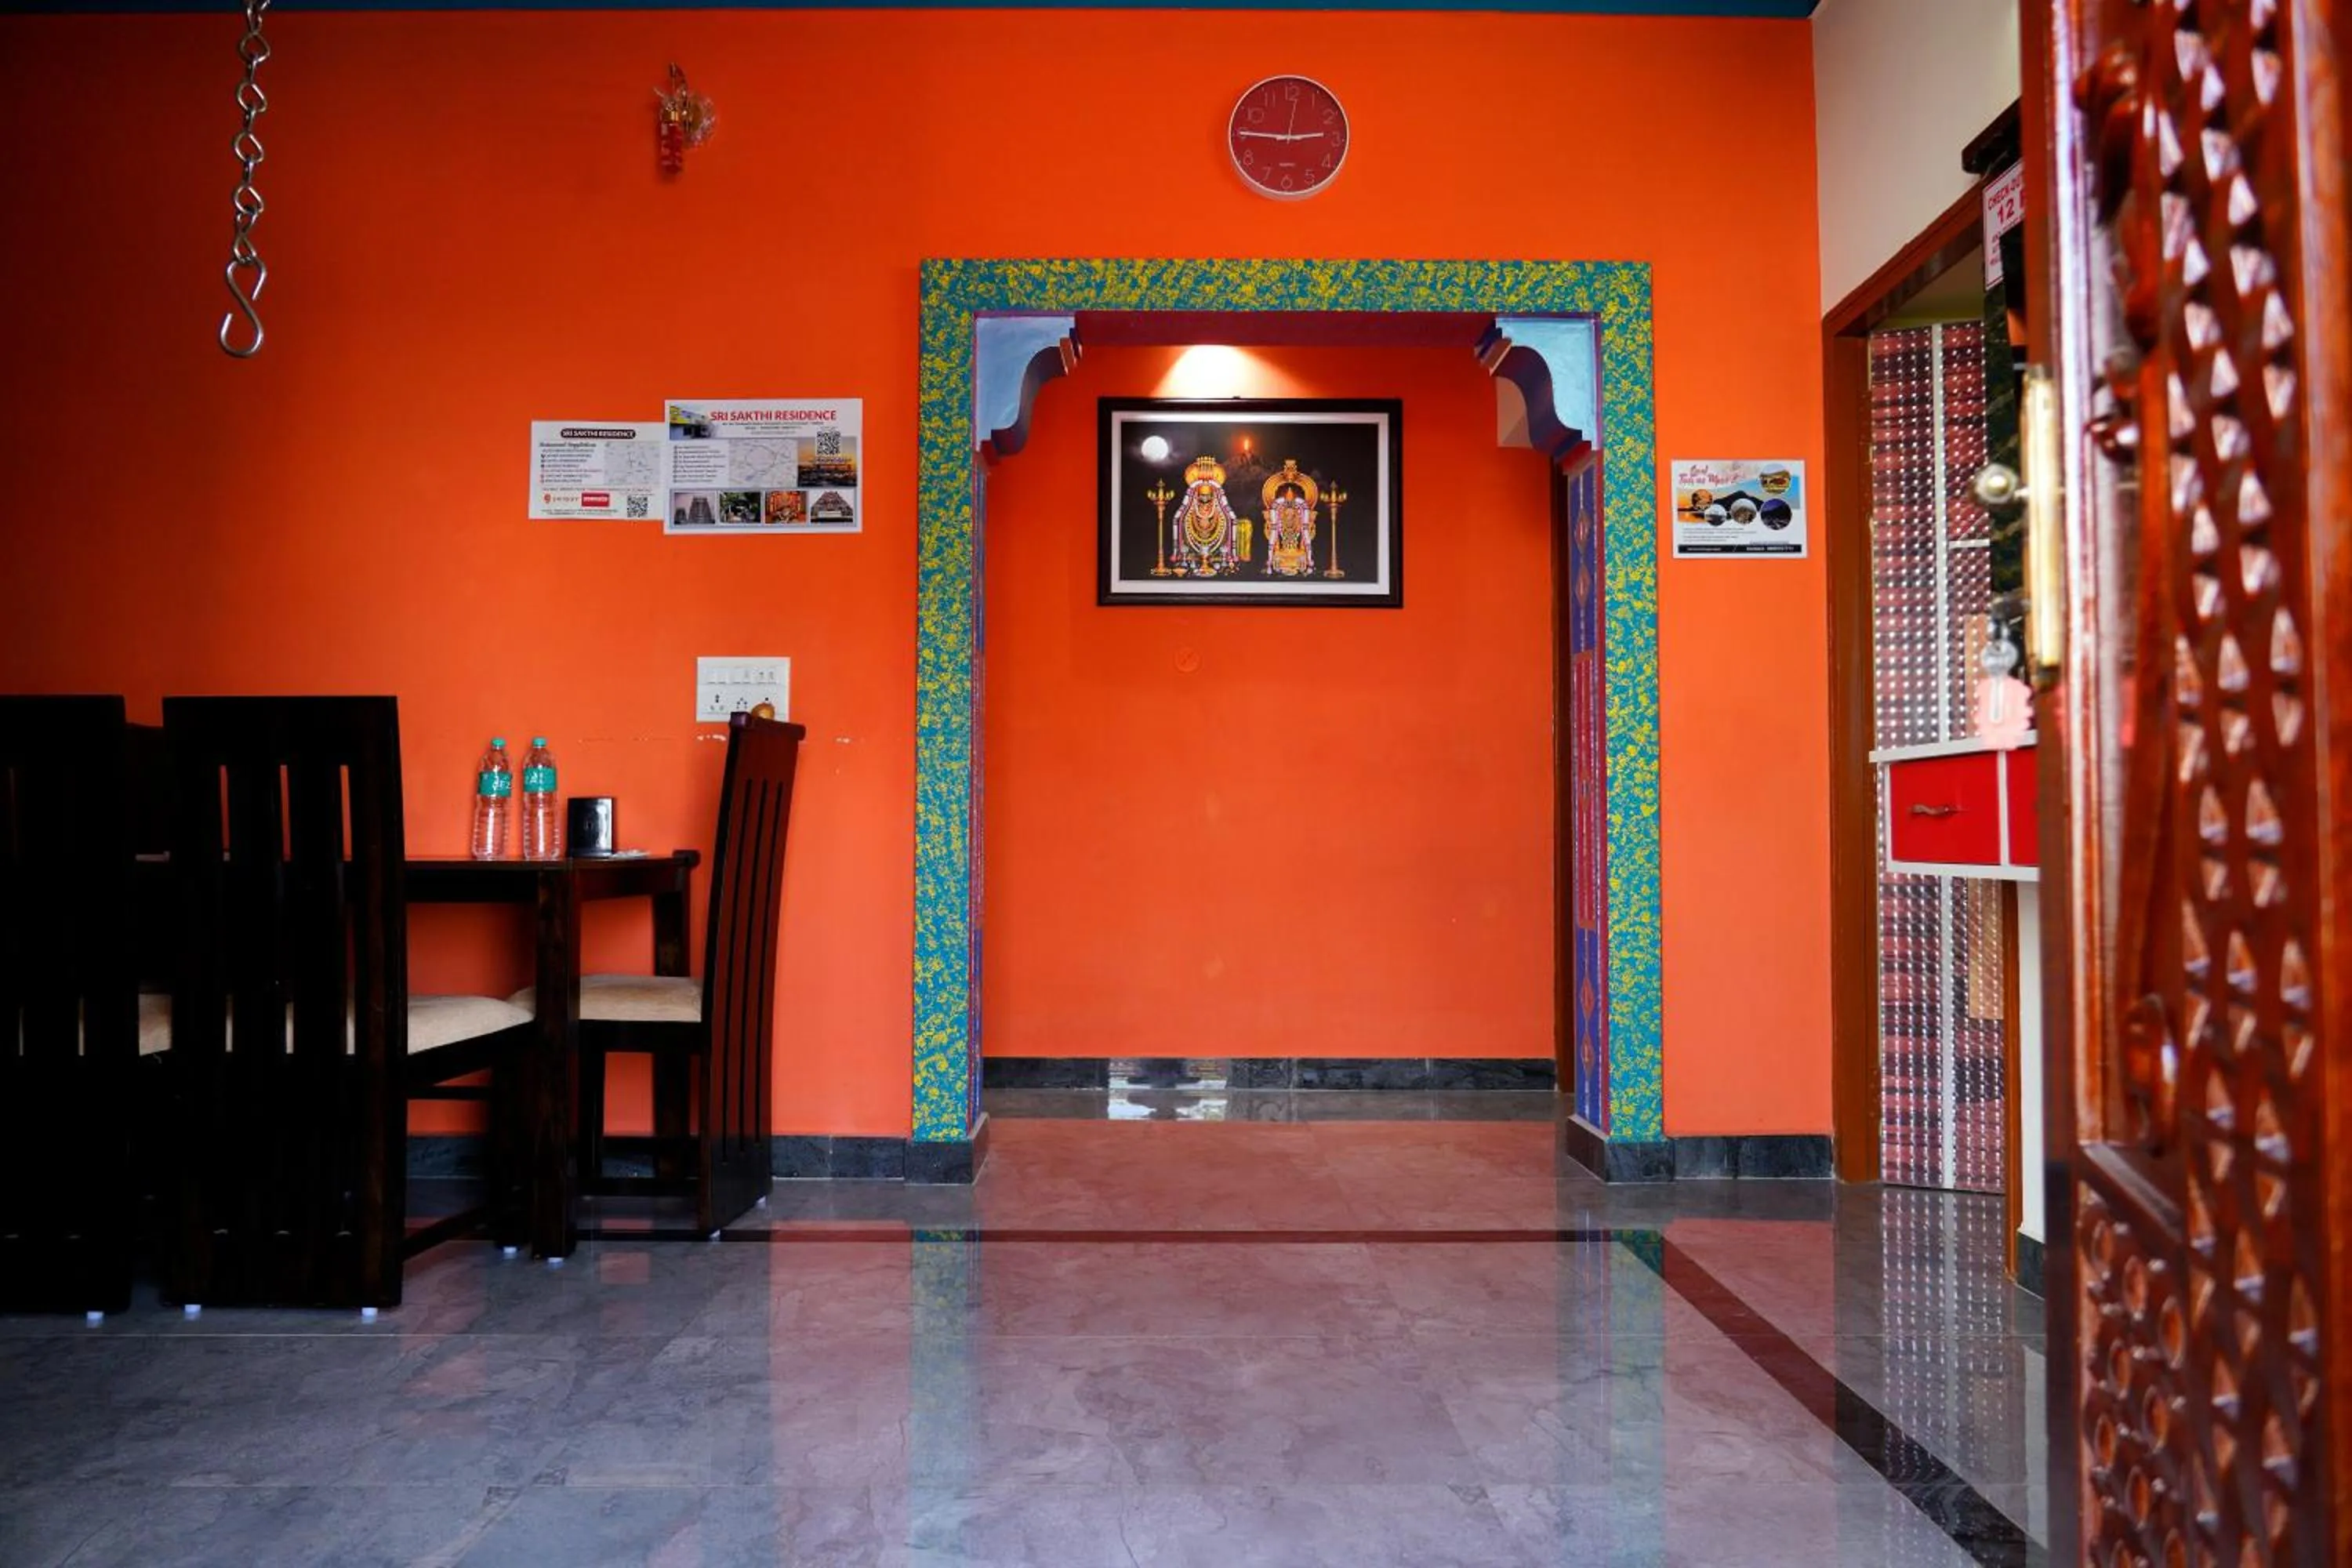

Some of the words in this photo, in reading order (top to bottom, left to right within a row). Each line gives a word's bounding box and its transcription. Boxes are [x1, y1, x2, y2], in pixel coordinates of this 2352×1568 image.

[1264, 92, 1276, 107] 11
[1284, 85, 1301, 101] 12
[1247, 107, 1265, 123] 10
[1323, 109, 1334, 124] 2
[1331, 132, 1341, 147] 3
[1243, 150, 1254, 166] 8
[1321, 154, 1331, 168] 4
[1261, 166, 1272, 181] 7
[1305, 169, 1315, 184] 5
[1280, 174, 1293, 189] 6
[1998, 198, 2015, 224] 12
[710, 412, 728, 422] SRI
[730, 411, 773, 421] SAKTHI
[775, 410, 837, 421] RESIDENCE
